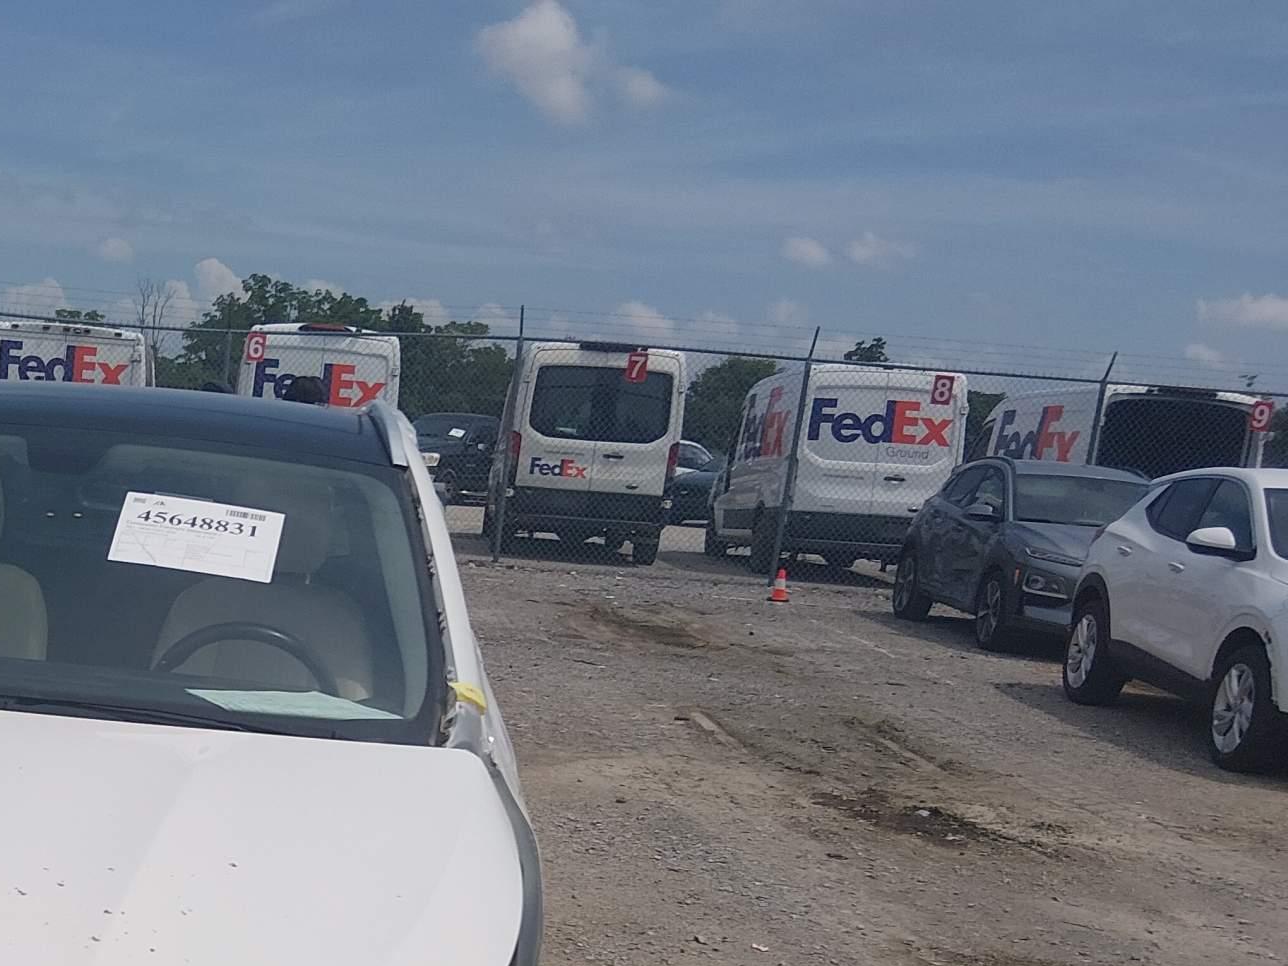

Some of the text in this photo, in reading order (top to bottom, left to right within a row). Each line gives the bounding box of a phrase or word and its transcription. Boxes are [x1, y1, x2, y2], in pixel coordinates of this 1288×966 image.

[248, 337, 263, 358] 6
[631, 356, 647, 378] 7
[934, 379, 951, 402] 8
[807, 397, 954, 447] FedEx
[1252, 405, 1269, 428] 9
[886, 447, 929, 460] Ground
[529, 456, 587, 479] FedEx
[137, 508, 259, 538] 45648831
